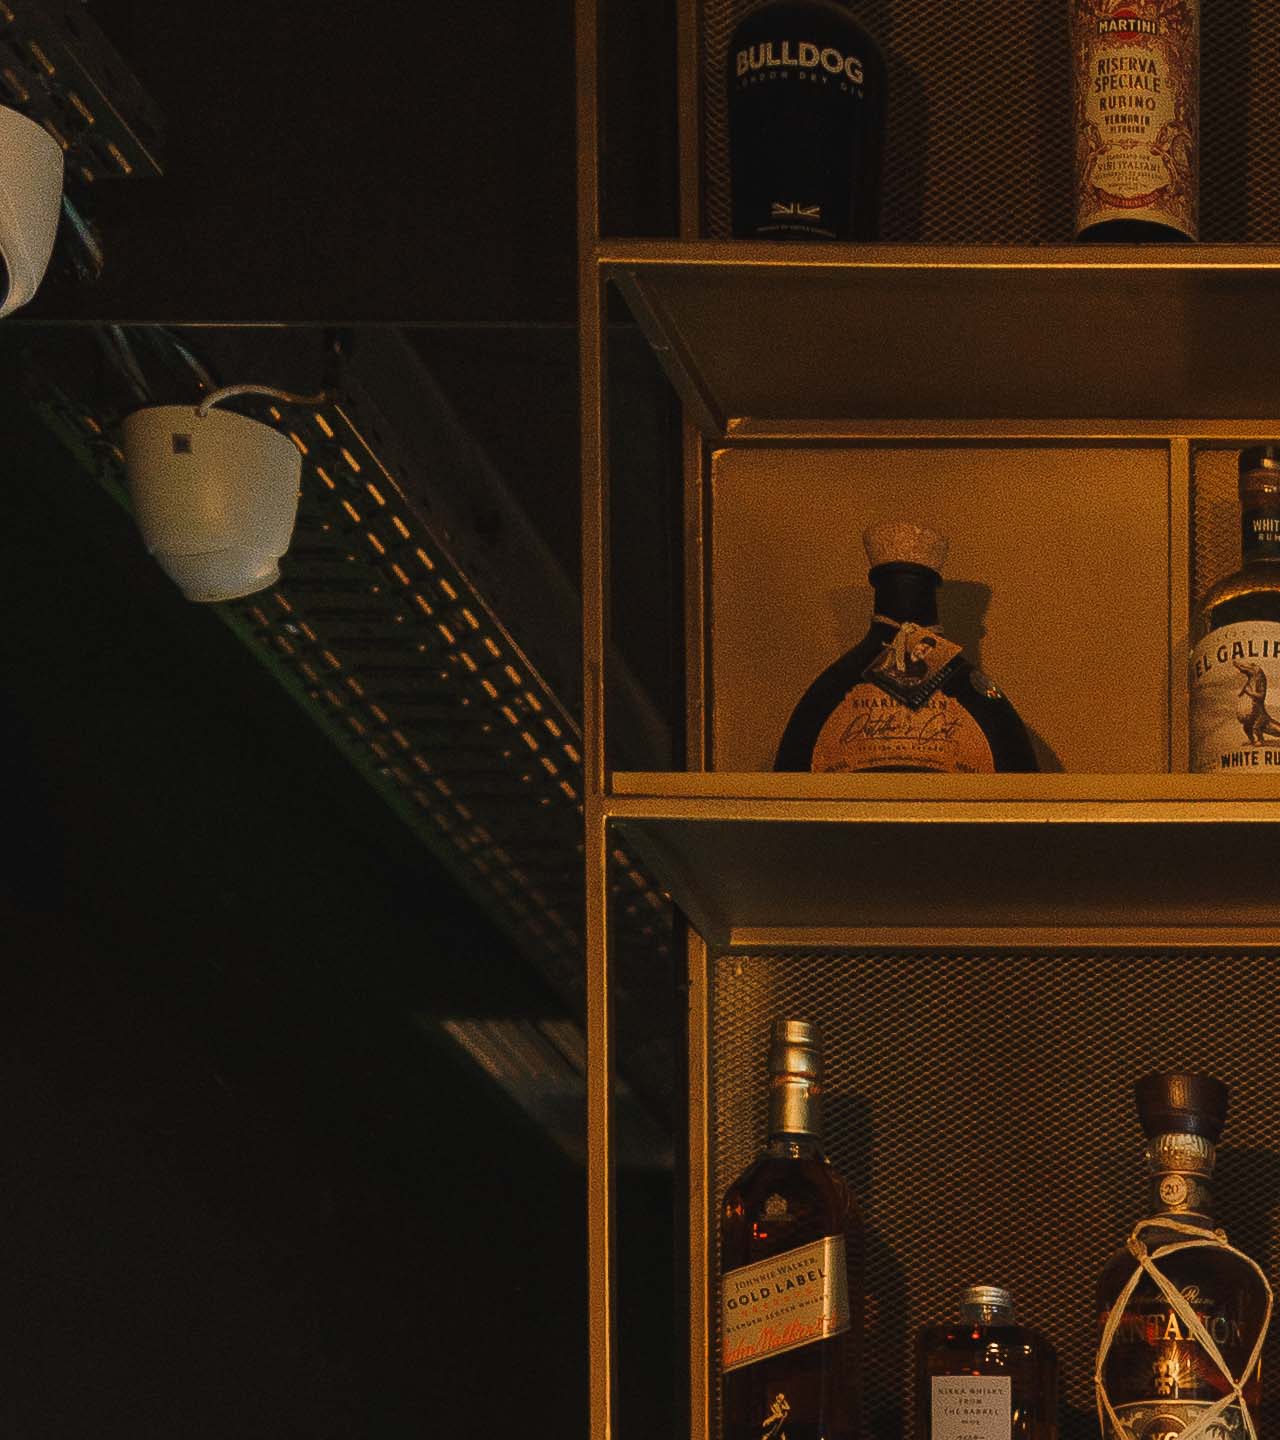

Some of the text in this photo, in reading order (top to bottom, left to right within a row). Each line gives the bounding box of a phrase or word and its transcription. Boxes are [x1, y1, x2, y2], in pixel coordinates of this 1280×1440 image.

[1098, 18, 1158, 34] MARTINI
[736, 40, 865, 85] BULLDOG
[1097, 58, 1158, 76] RISERVA
[1094, 75, 1161, 94] SPECIALE
[1100, 98, 1156, 113] RUBINO
[1196, 657, 1213, 678] EL
[1220, 750, 1260, 768] WHITE
[734, 1257, 816, 1293] JOHNNIE WALKER
[726, 1267, 828, 1312] GOLD LABEL
